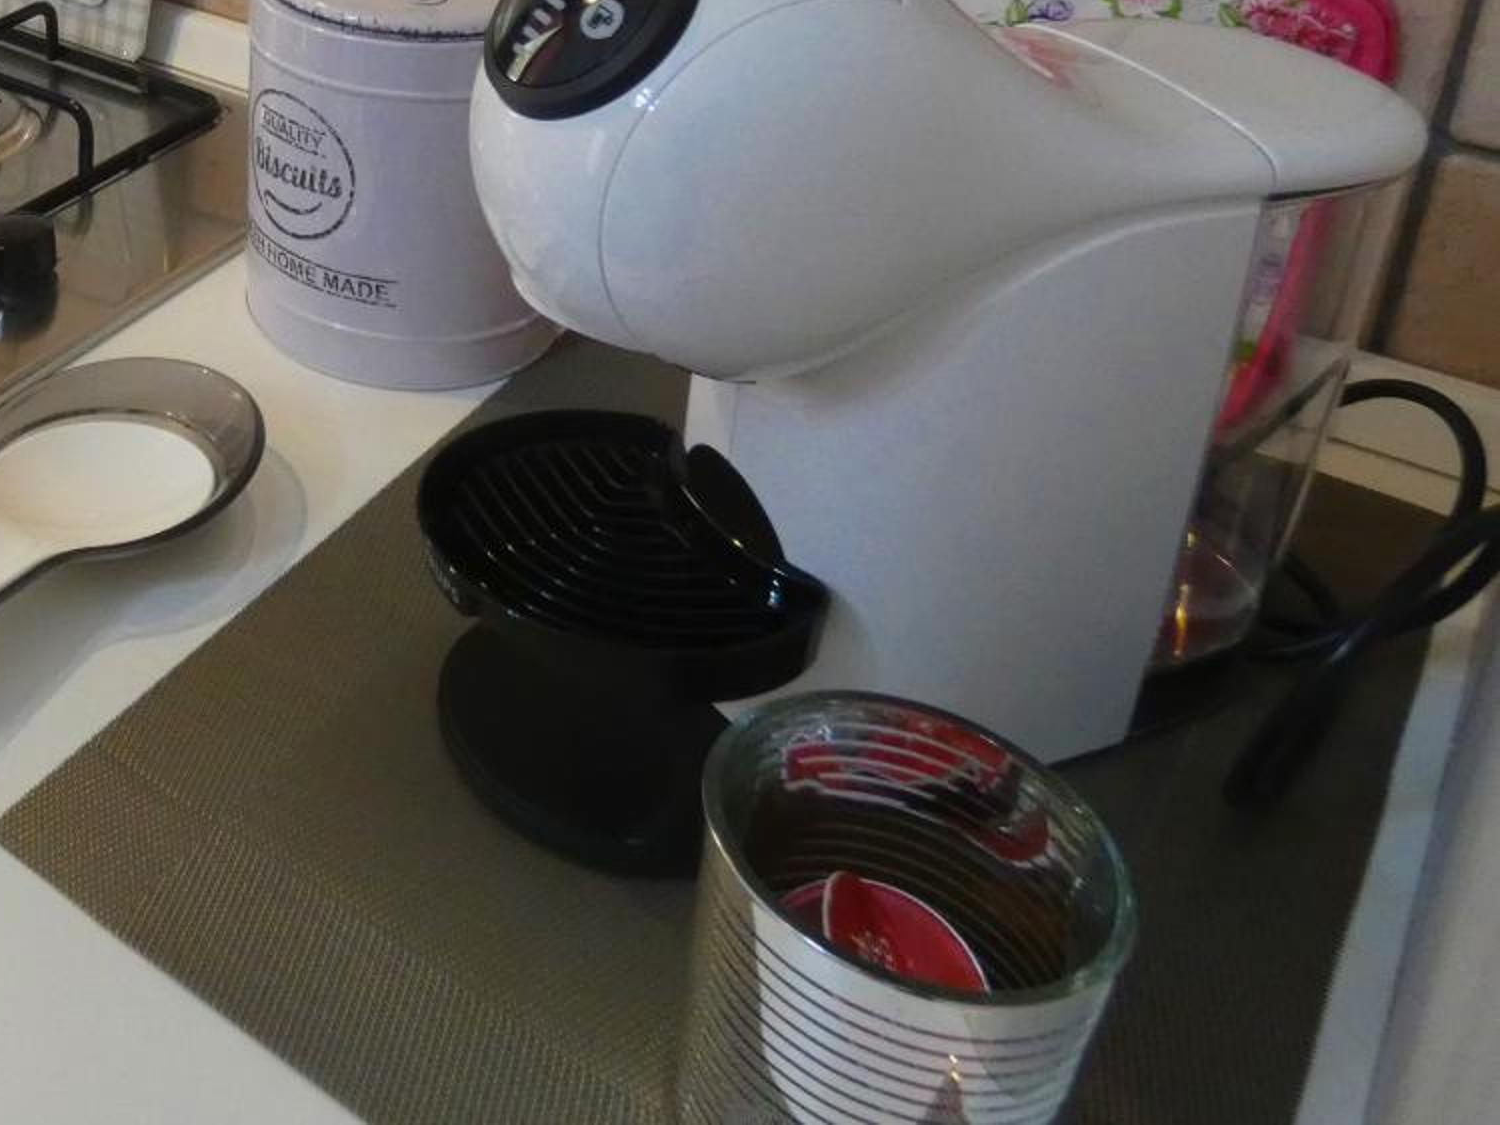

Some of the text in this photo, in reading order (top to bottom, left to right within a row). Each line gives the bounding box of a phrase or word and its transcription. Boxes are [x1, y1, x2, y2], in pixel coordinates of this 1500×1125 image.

[263, 111, 323, 149] QUALITY
[256, 137, 342, 198] Biscuits
[267, 243, 389, 300] HOME MADE
